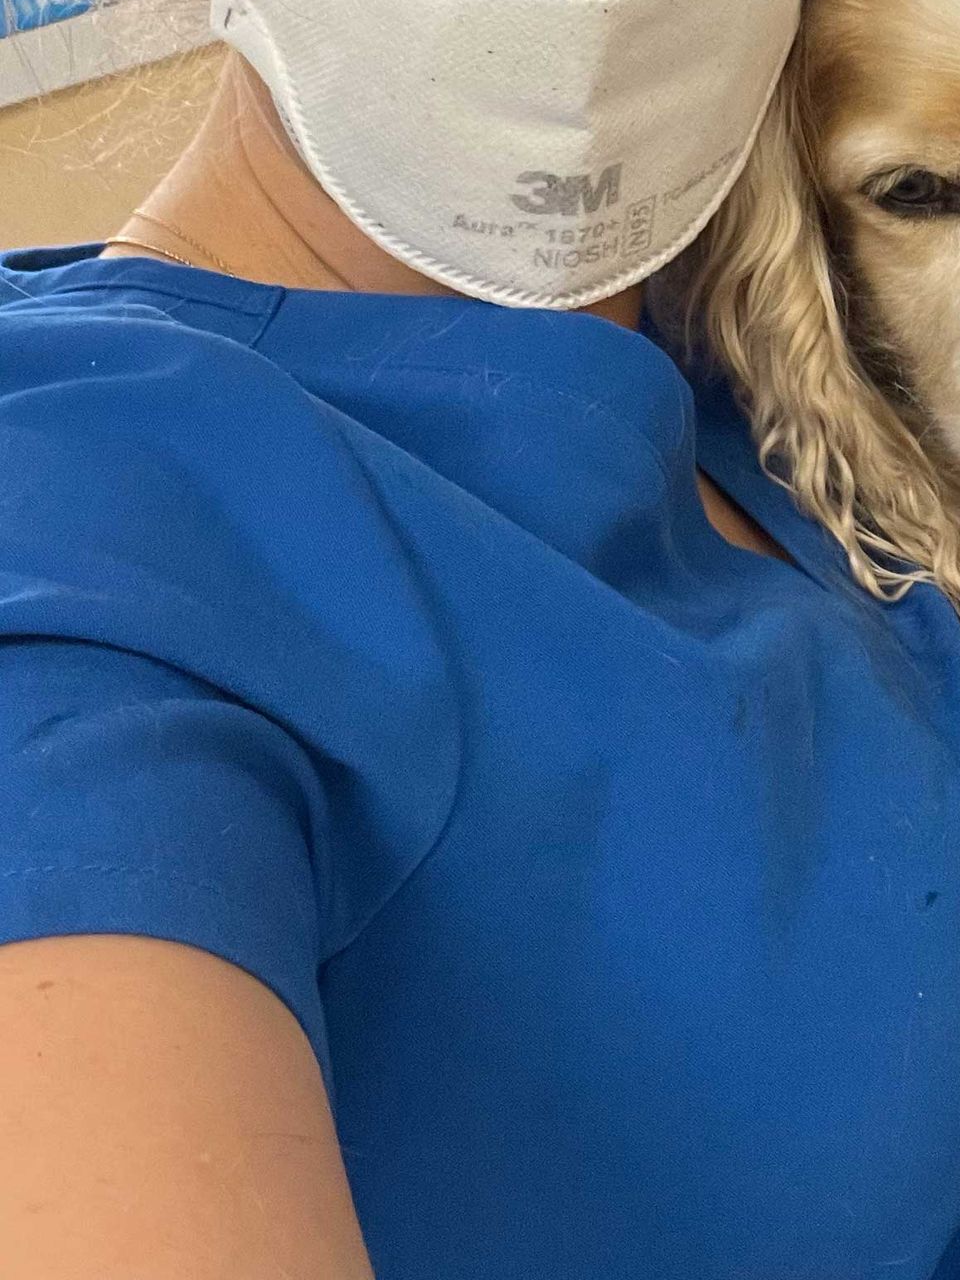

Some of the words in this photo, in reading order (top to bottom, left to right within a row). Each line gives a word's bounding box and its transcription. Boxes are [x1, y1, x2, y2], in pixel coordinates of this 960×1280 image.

[508, 162, 623, 216] 3M
[629, 204, 650, 248] N95
[533, 237, 620, 269] NIOSH
